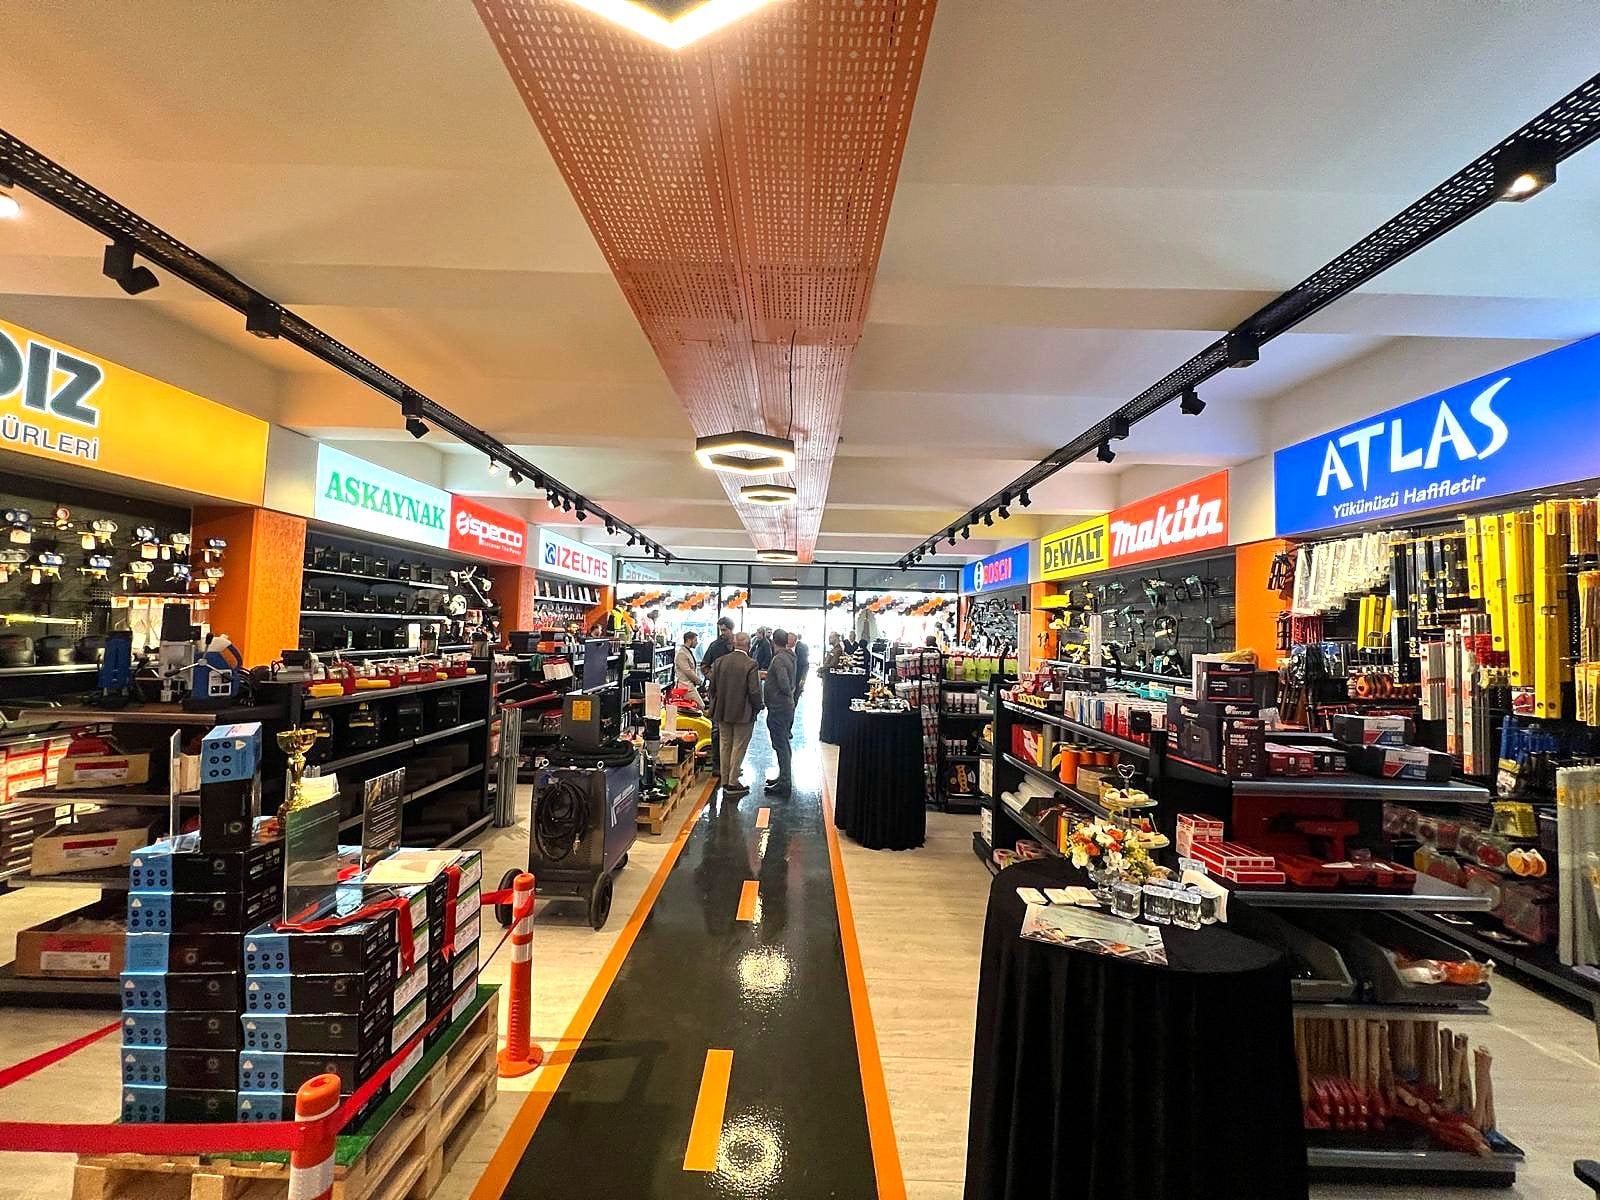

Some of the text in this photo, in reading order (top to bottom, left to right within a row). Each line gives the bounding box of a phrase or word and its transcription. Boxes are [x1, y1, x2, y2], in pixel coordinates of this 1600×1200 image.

[1316, 377, 1512, 497] ATLAS
[324, 471, 446, 530] ASKAYNAK
[1333, 474, 1487, 519] Yükünüzü Hafifletir
[983, 557, 1012, 584] BOSCH
